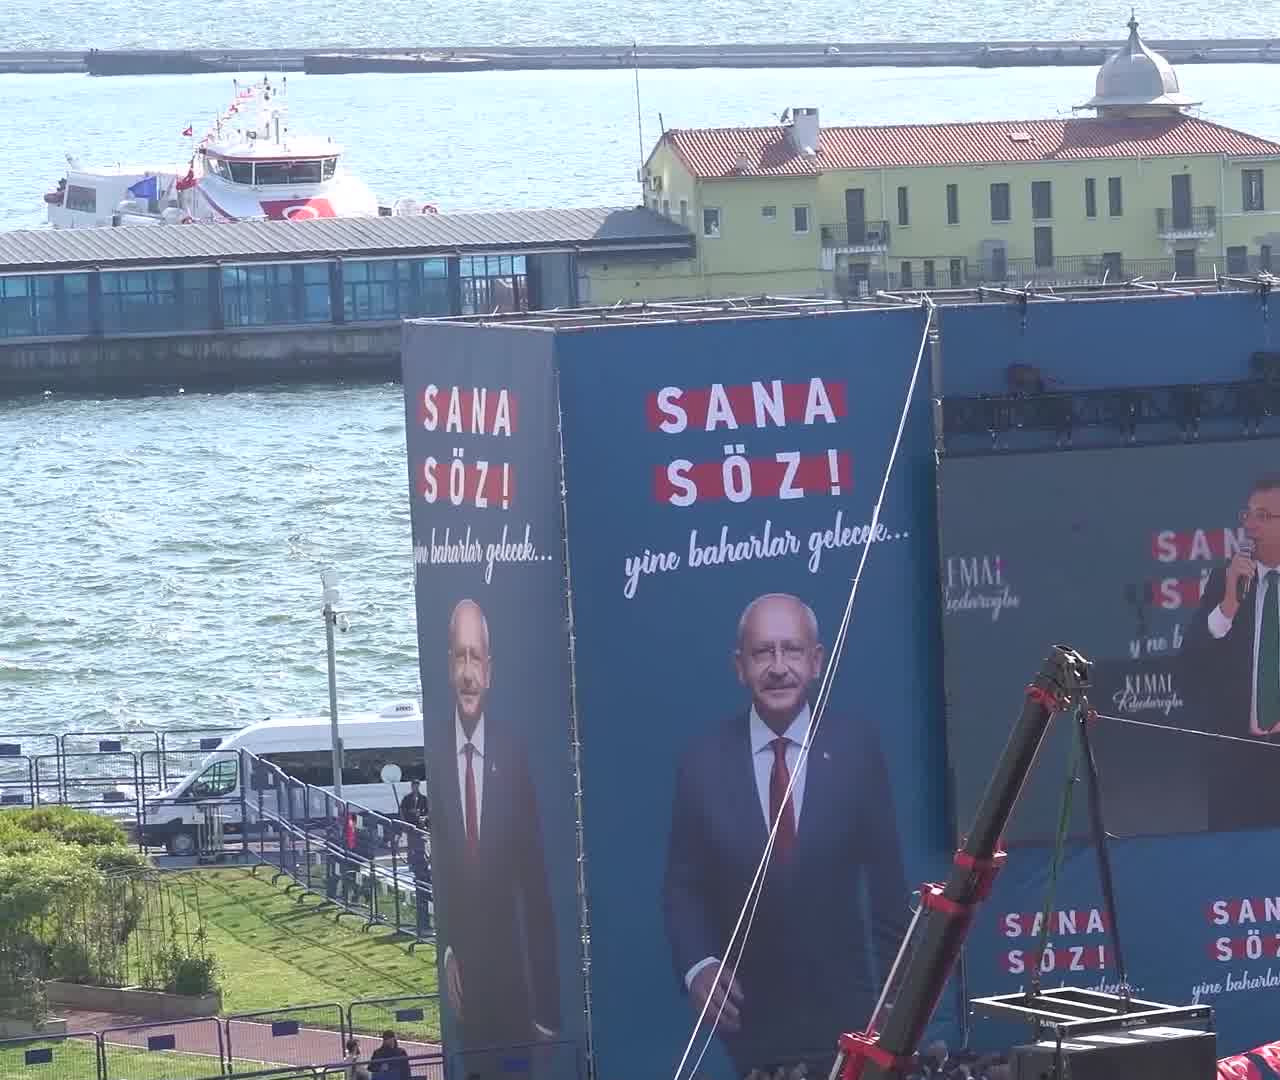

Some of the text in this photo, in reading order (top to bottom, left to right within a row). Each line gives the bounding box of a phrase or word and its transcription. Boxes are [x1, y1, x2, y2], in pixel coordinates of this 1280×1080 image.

[423, 384, 512, 437] SANA
[657, 376, 837, 435] SANA
[423, 447, 510, 510] SÖZ!
[667, 443, 843, 507] SÖZ!
[430, 526, 483, 564] baharlar
[623, 548, 680, 599] yine
[689, 520, 799, 568] baharlar
[1157, 528, 1246, 562] SAN
[1005, 908, 1105, 937] SANA
[1008, 942, 1105, 974] SÖZ!
[1191, 978, 1224, 1006] yine
